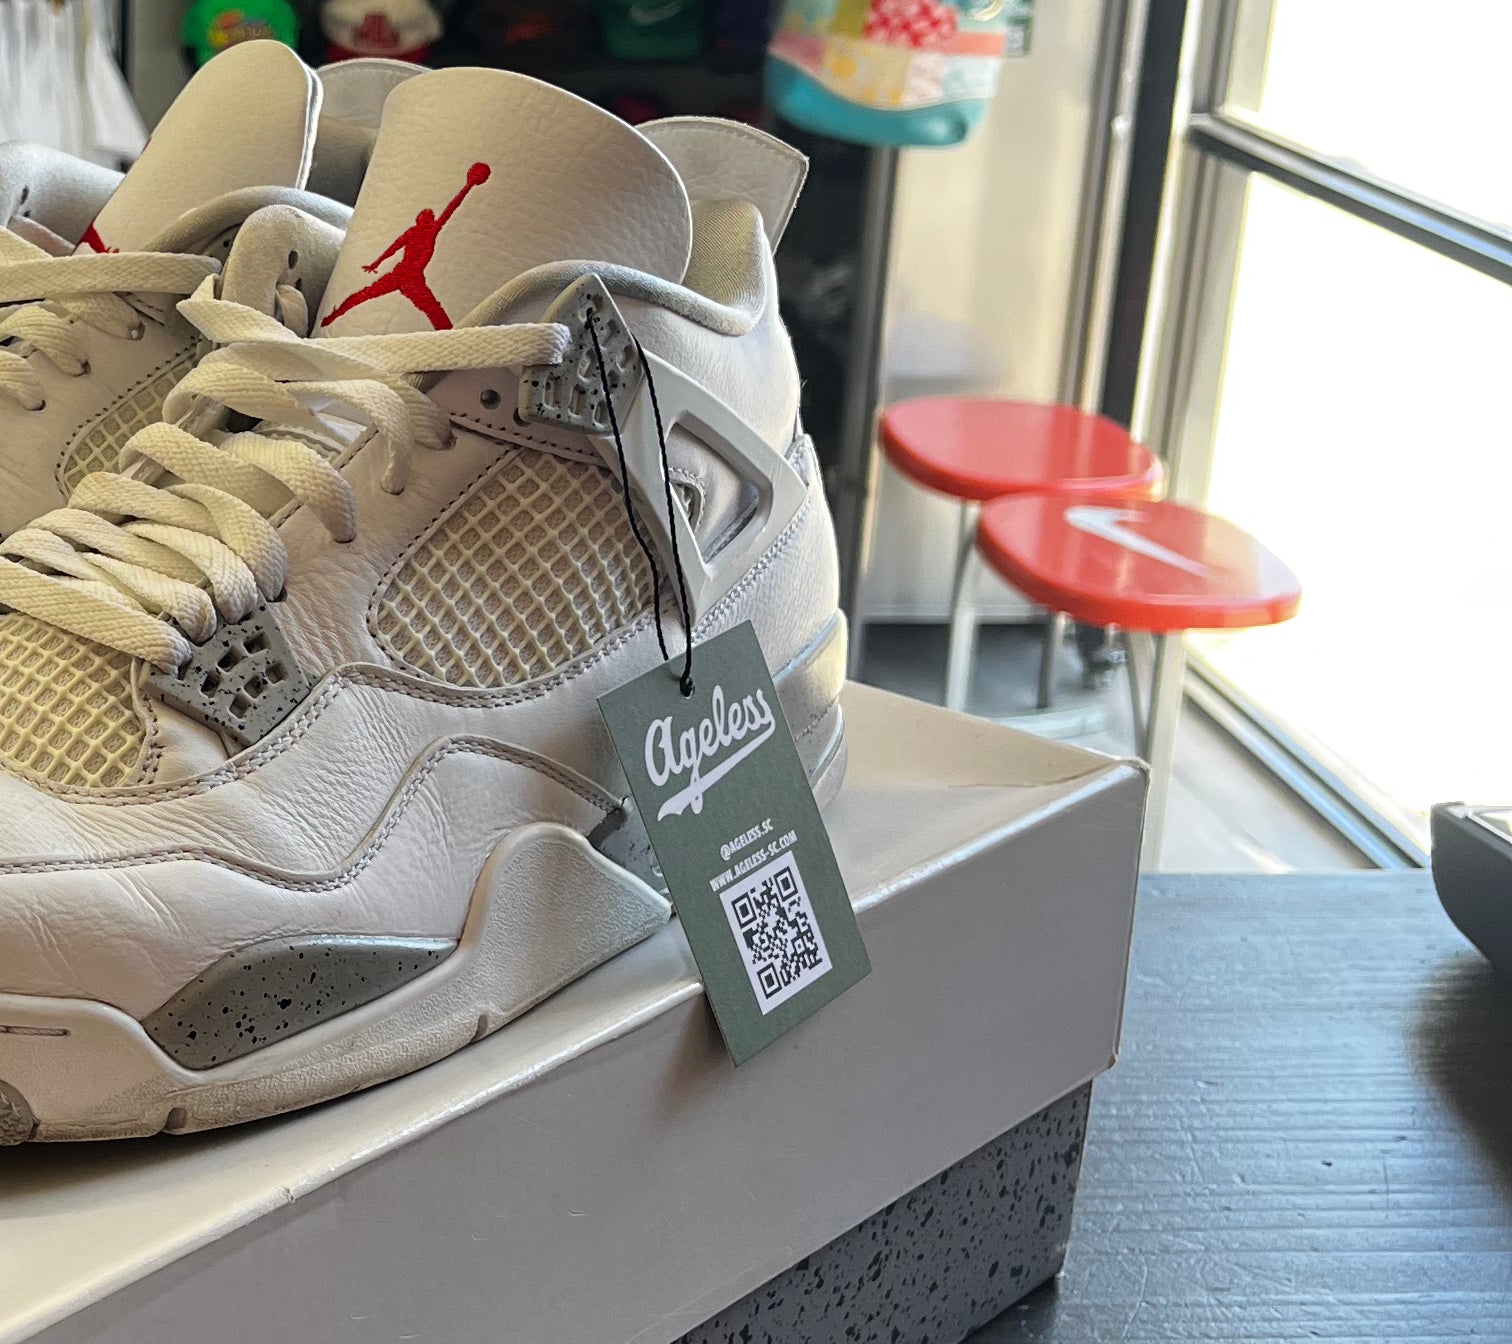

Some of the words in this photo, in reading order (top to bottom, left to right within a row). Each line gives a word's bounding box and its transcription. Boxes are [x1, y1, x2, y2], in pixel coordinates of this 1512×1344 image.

[644, 684, 776, 821] Ageless
[709, 829, 799, 892] WWW.AGELESS-SC.COM
[719, 817, 774, 861] @AGELESS.SC
